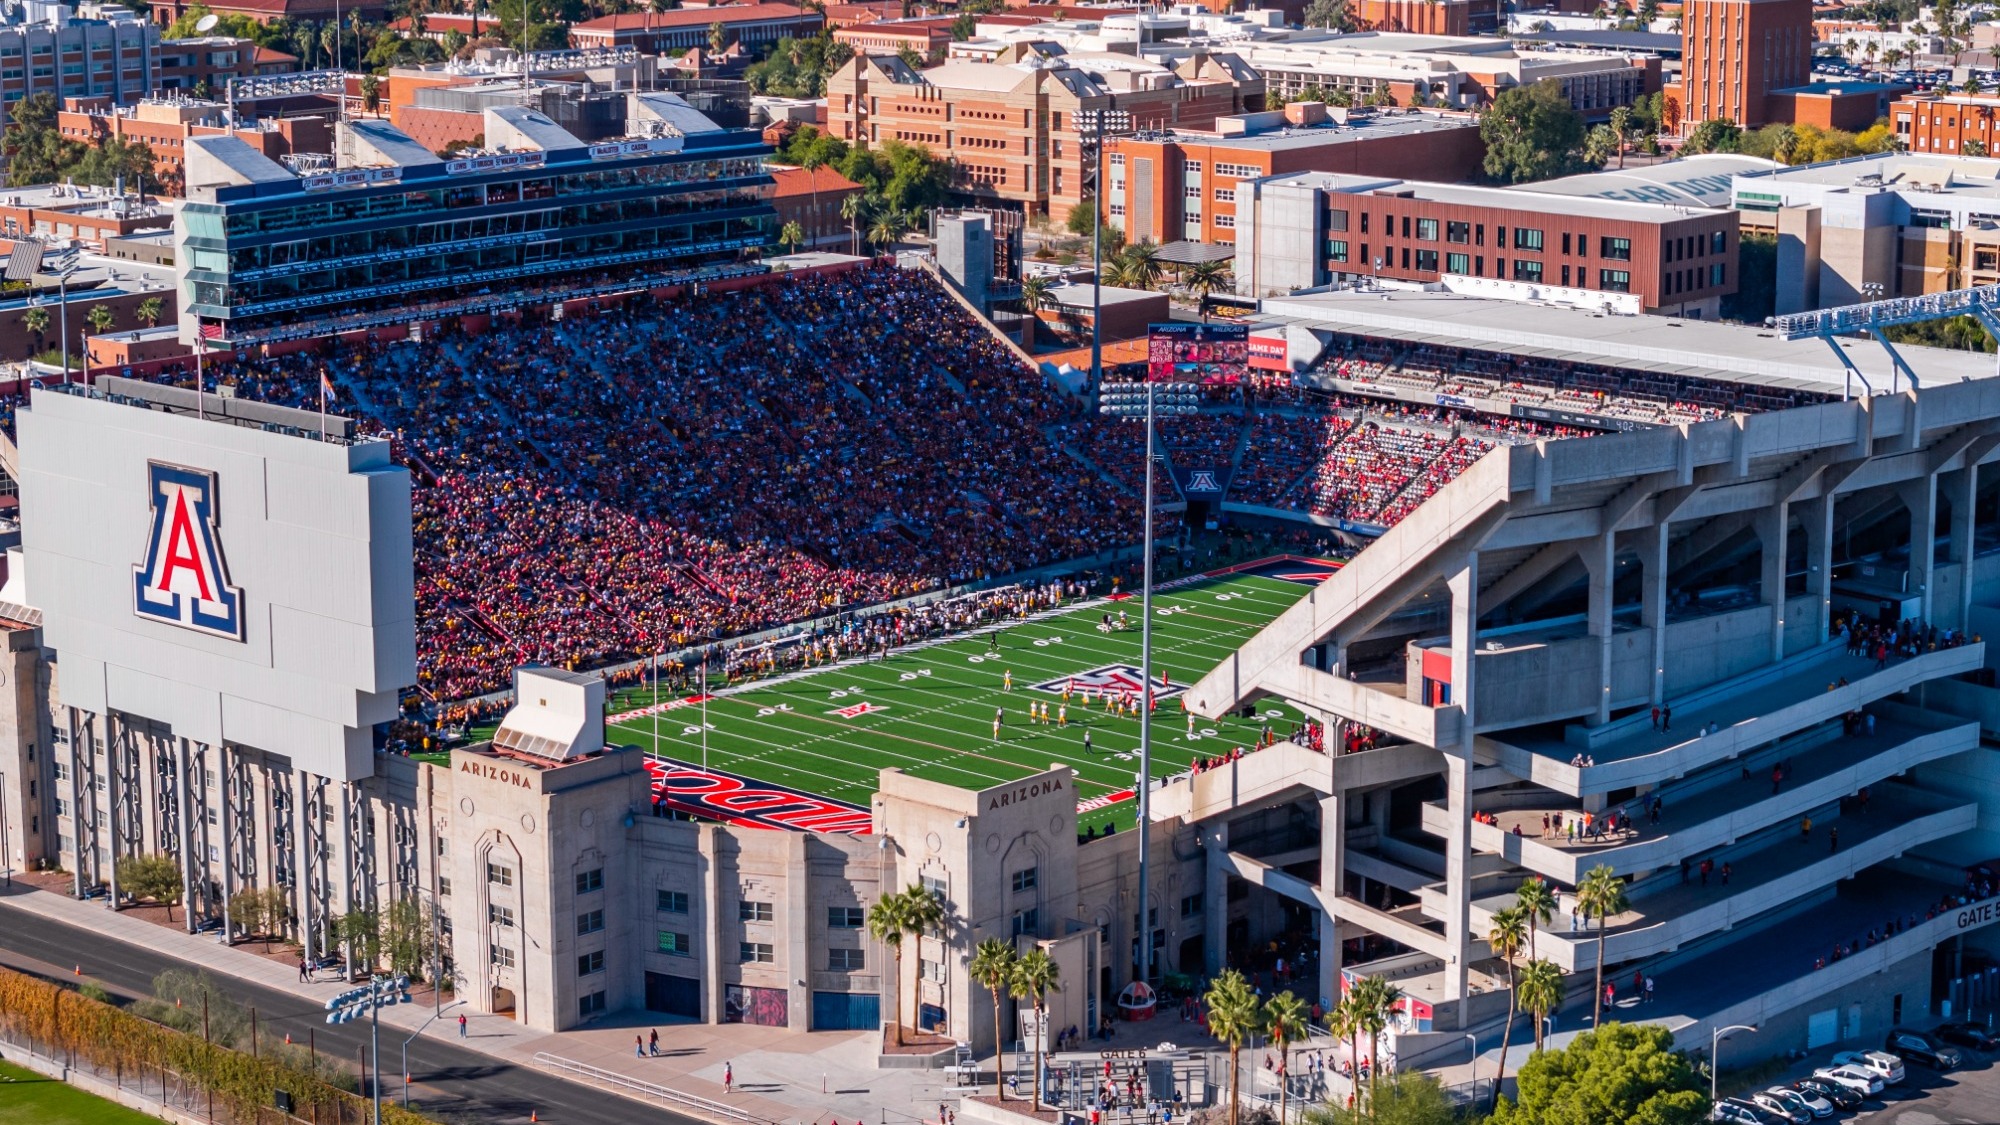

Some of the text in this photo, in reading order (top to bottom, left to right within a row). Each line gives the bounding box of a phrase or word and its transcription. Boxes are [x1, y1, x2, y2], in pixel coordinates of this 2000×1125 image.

[312, 177, 334, 187] LUPPINO
[346, 173, 366, 182] HUNLEY
[1584, 185, 1680, 203] EAR
[1270, 346, 1284, 355] DAY
[132, 459, 242, 643] A
[461, 760, 532, 790] ARIZONA
[989, 779, 1062, 810] ARIZONA
[1958, 904, 1992, 928] GATE
[1100, 1048, 1146, 1059] GATE 6
